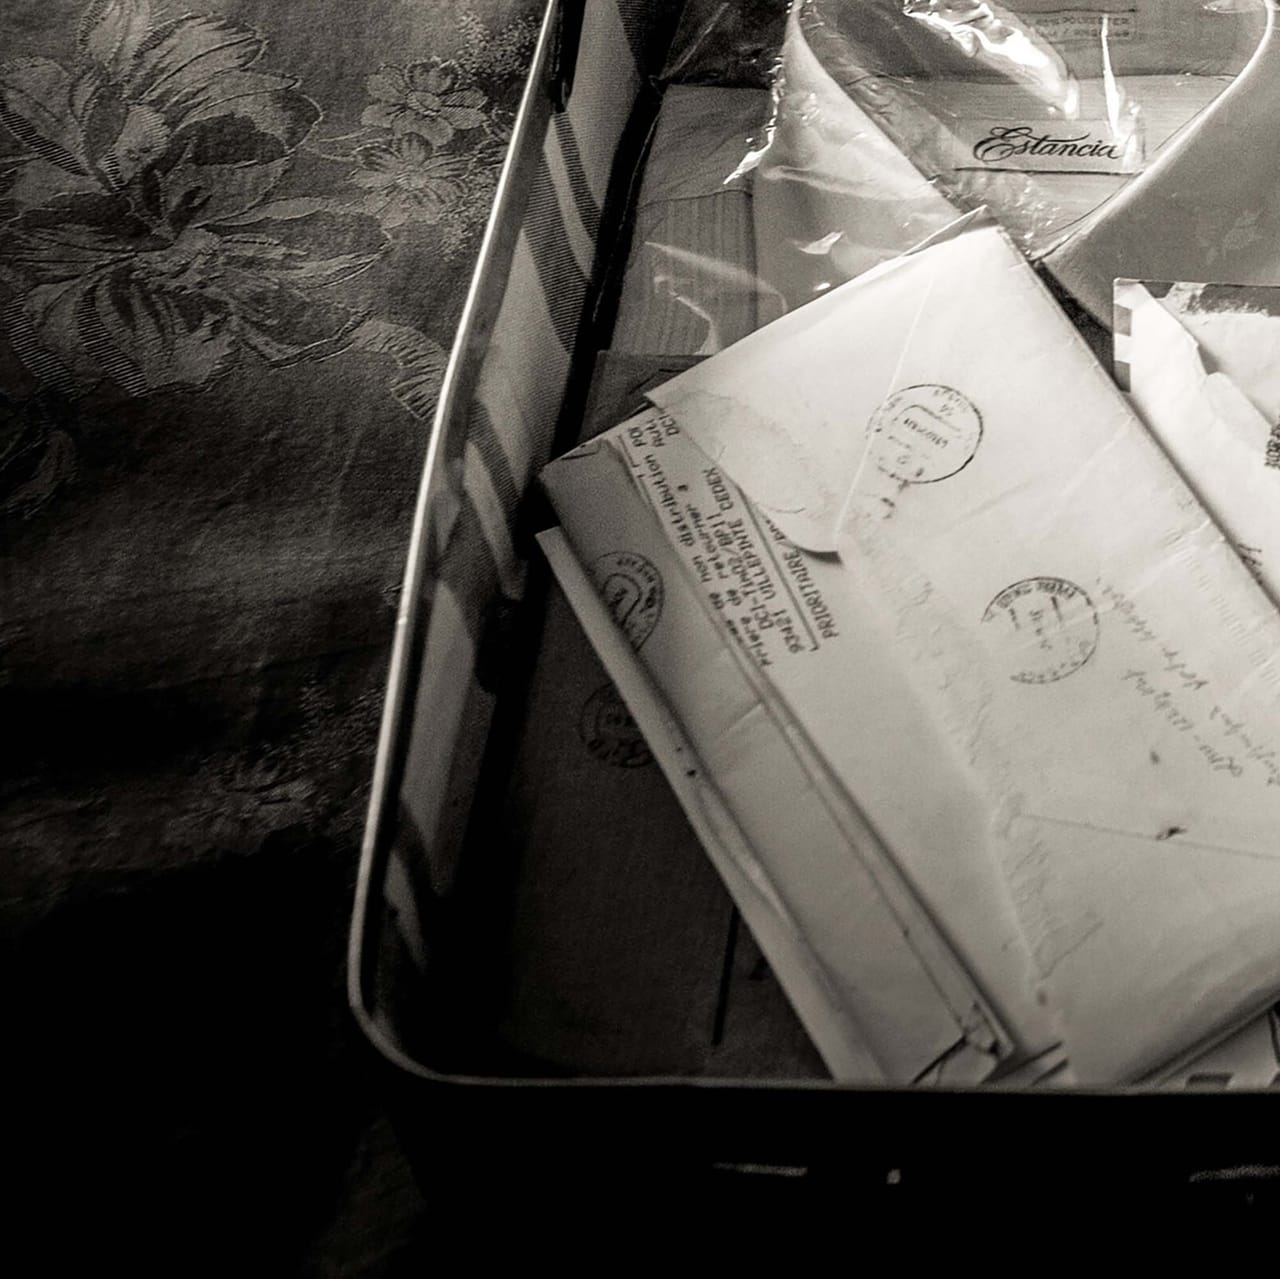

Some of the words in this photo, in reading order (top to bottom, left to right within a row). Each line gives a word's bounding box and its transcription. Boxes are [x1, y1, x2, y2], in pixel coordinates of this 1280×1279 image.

[973, 127, 1121, 163] Estancia
[643, 454, 695, 548] distribution
[703, 466, 733, 511] CEDEX
[684, 503, 730, 580] retourner
[728, 518, 777, 601] VILLEPINTE
[691, 554, 712, 583] non
[723, 586, 743, 608] de
[772, 609, 804, 654] 93421
